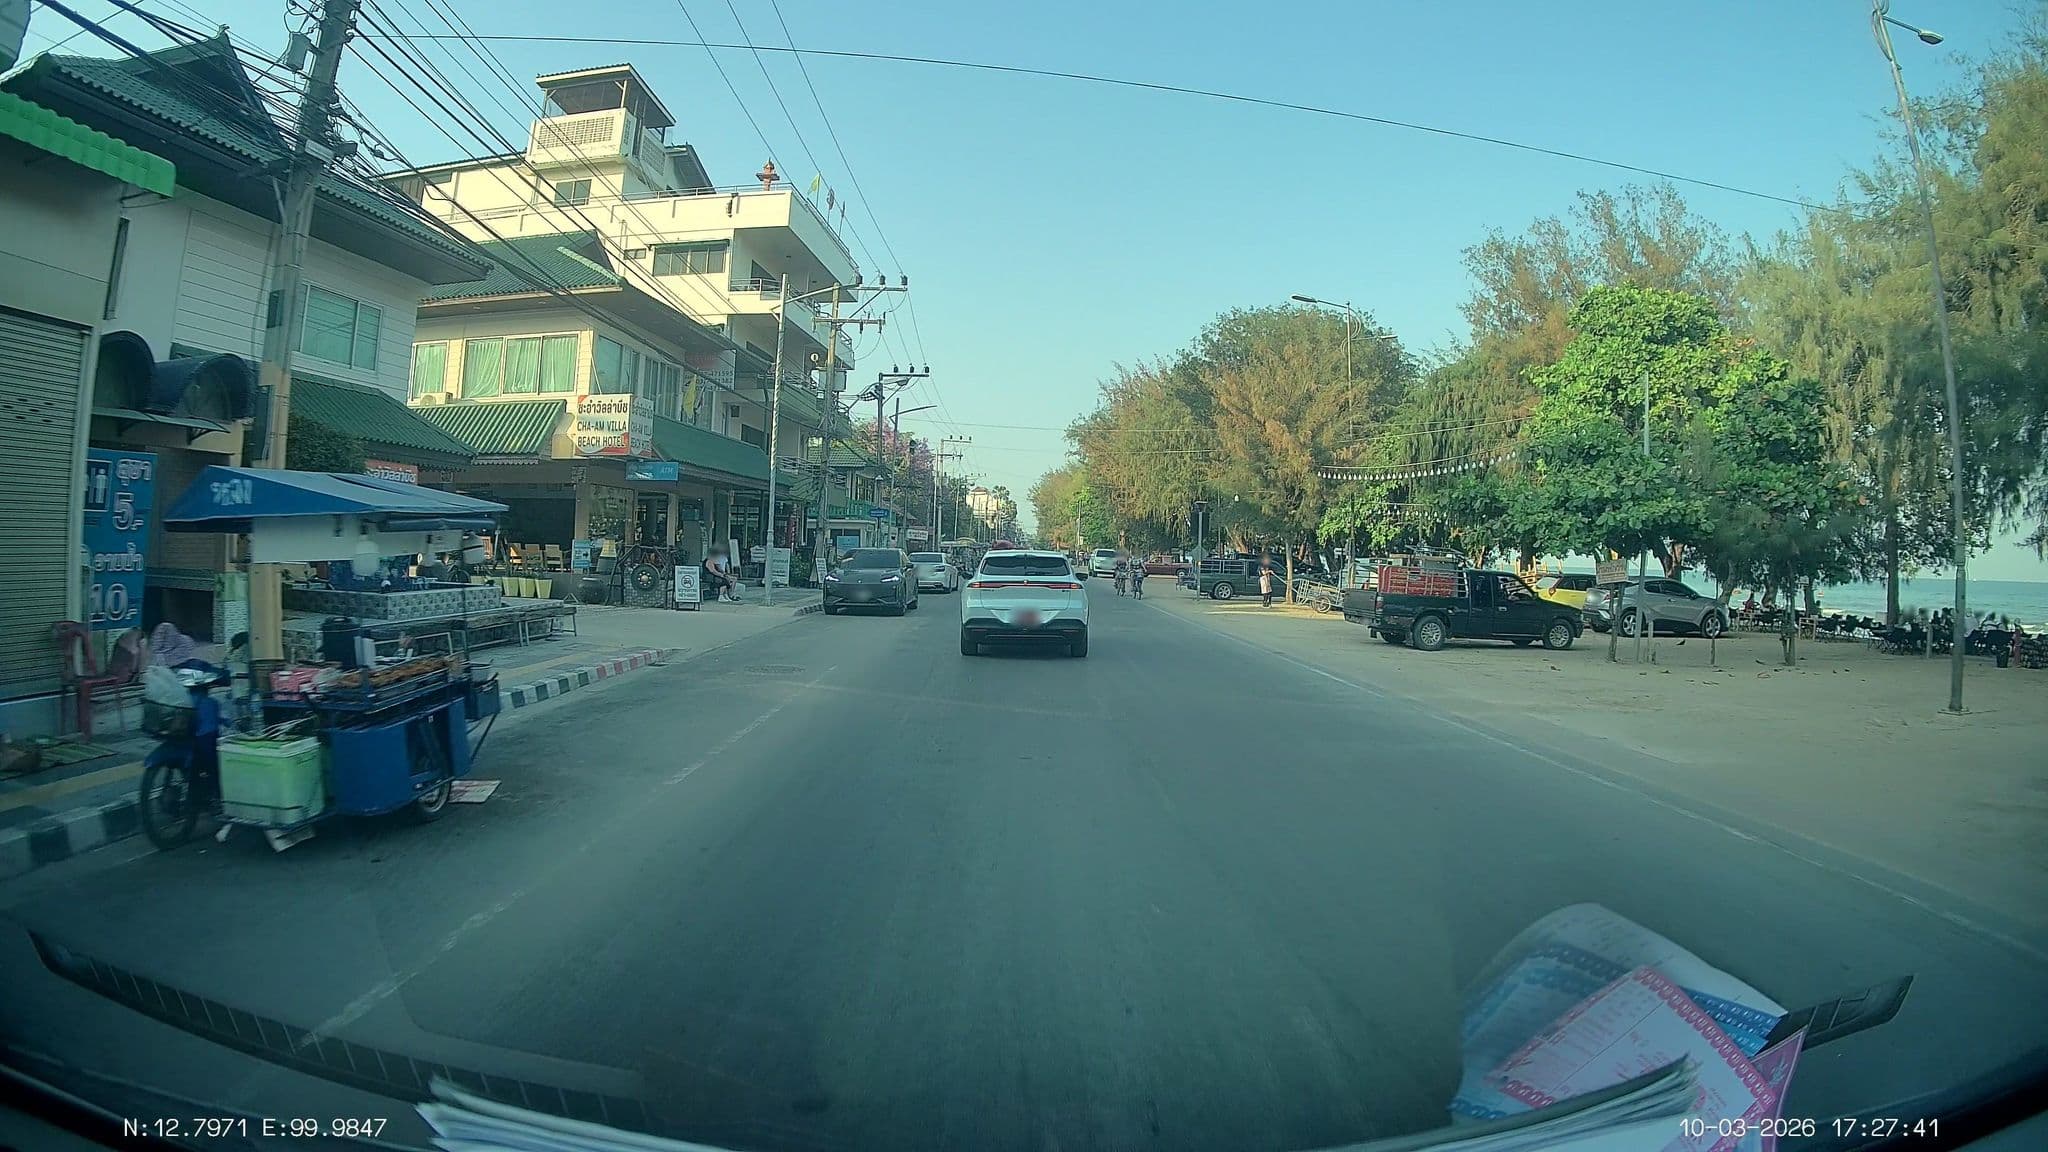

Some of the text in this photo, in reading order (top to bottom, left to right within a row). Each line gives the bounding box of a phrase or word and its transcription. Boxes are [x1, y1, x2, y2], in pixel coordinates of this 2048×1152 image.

[577, 399, 628, 414] ชะอำวิลล่าบีช
[577, 420, 604, 432] CHA-AM
[607, 420, 627, 431] VILLA
[577, 436, 600, 447] BEACH
[602, 436, 625, 447] HOTEL
